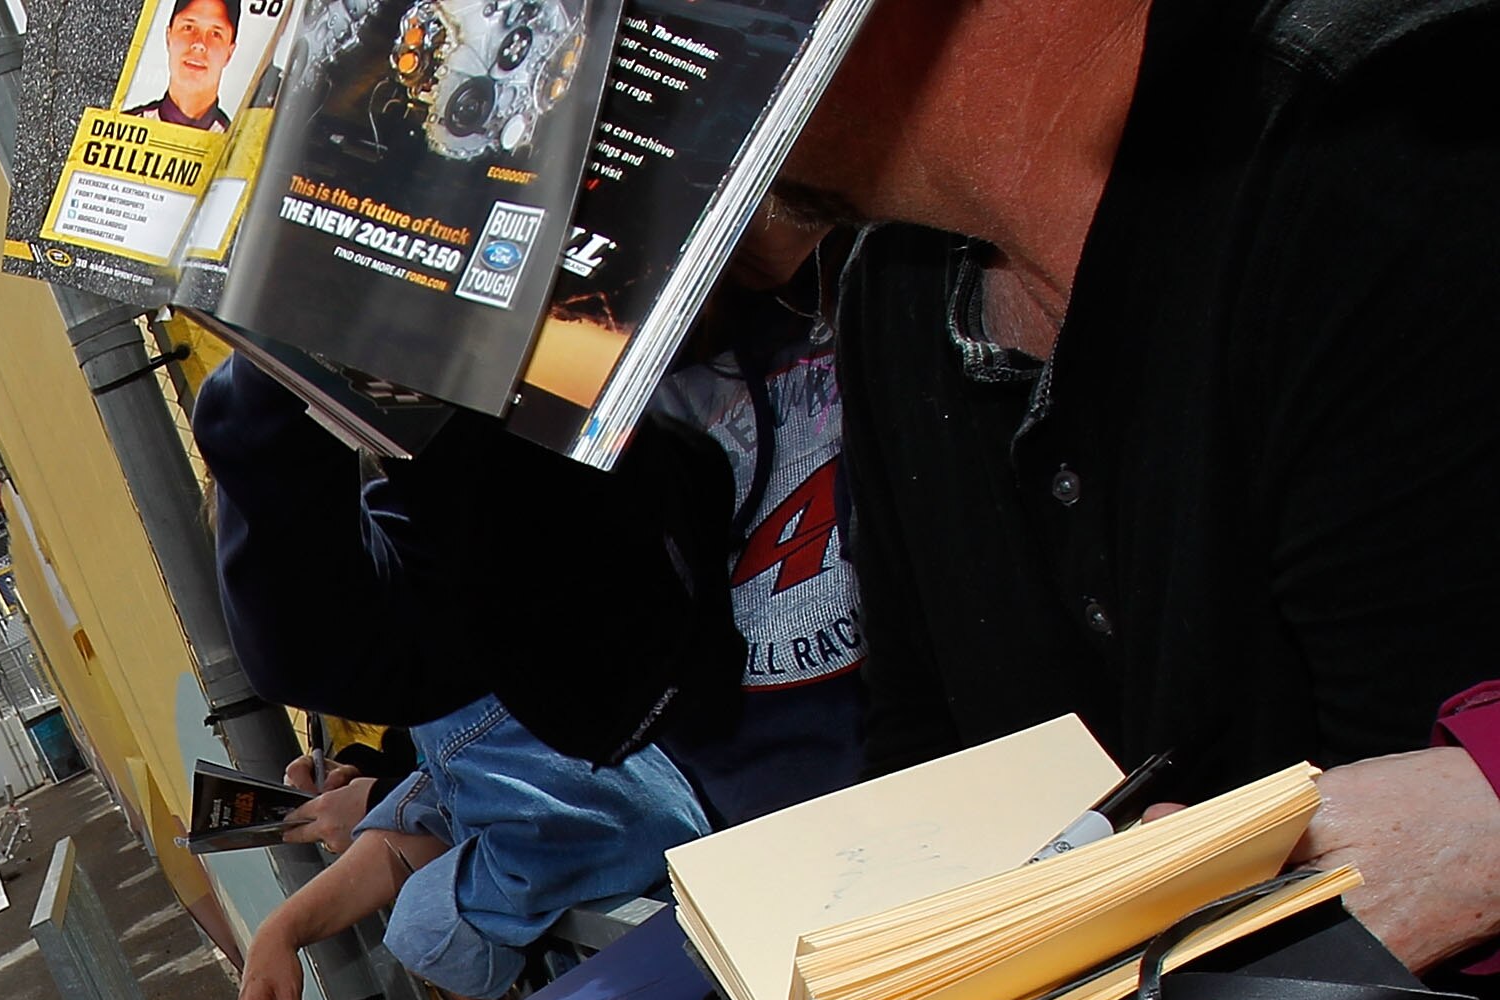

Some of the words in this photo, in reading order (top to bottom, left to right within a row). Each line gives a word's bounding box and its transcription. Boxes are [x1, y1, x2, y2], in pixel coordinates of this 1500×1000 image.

[90, 119, 149, 145] DAVID
[83, 140, 203, 187] GILLILAND
[289, 175, 315, 197] This
[315, 182, 330, 201] is
[331, 188, 358, 211] the
[358, 198, 410, 229] future
[411, 217, 433, 234] of
[431, 222, 471, 246] truck
[488, 210, 539, 242] BUILT
[279, 197, 313, 225] THE
[310, 206, 360, 239] NEW
[355, 222, 408, 257] 2011
[406, 238, 462, 273] F-150
[333, 246, 355, 261] FIND
[353, 252, 372, 267] OUT
[370, 259, 397, 276] MORE
[393, 267, 408, 278] AT
[404, 270, 448, 291] FORD.COM
[467, 267, 514, 297] TOUGH
[731, 454, 841, 597] 4
[793, 609, 861, 672] RAC
